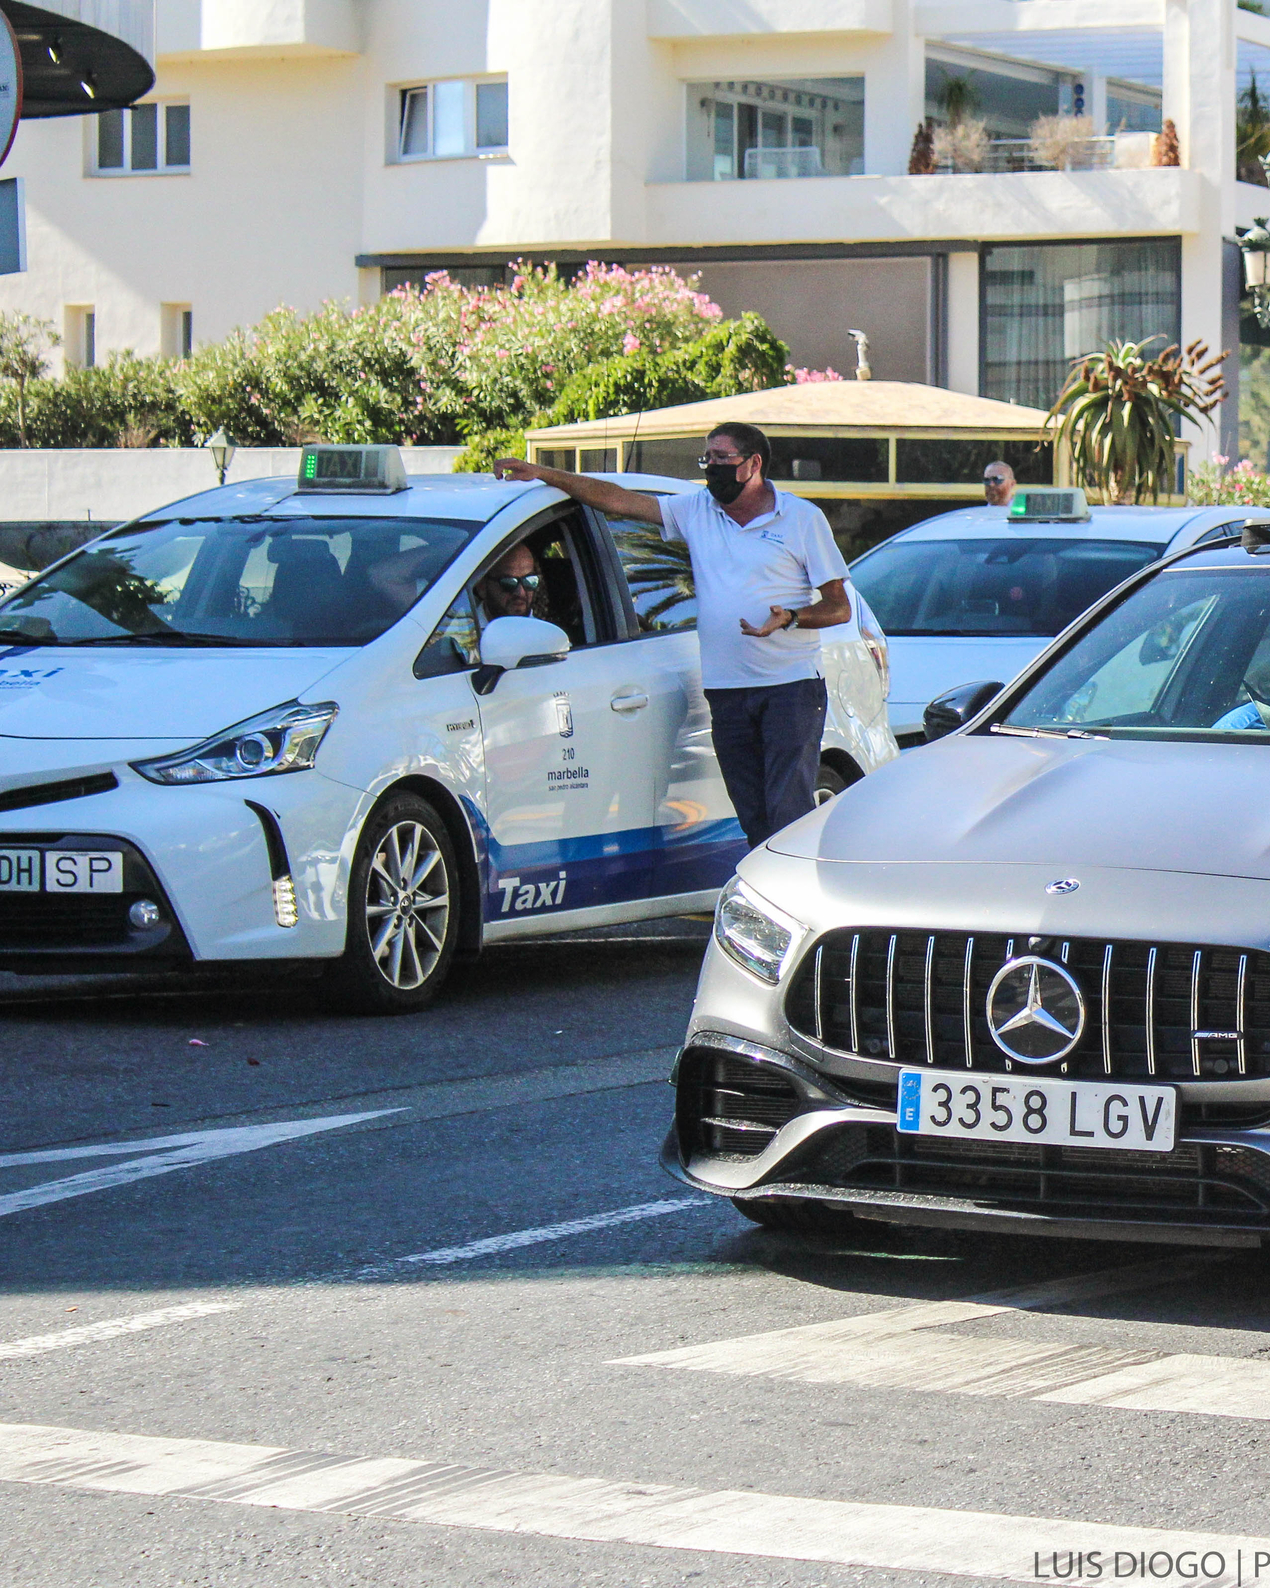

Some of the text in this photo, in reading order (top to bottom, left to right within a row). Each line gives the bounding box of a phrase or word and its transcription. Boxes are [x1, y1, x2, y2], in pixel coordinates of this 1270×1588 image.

[562, 747, 575, 761] 210
[547, 766, 589, 781] marbella
[55, 856, 113, 888] SP
[497, 870, 567, 913] Taxi
[905, 1082, 1164, 1142] E 3358 LGV
